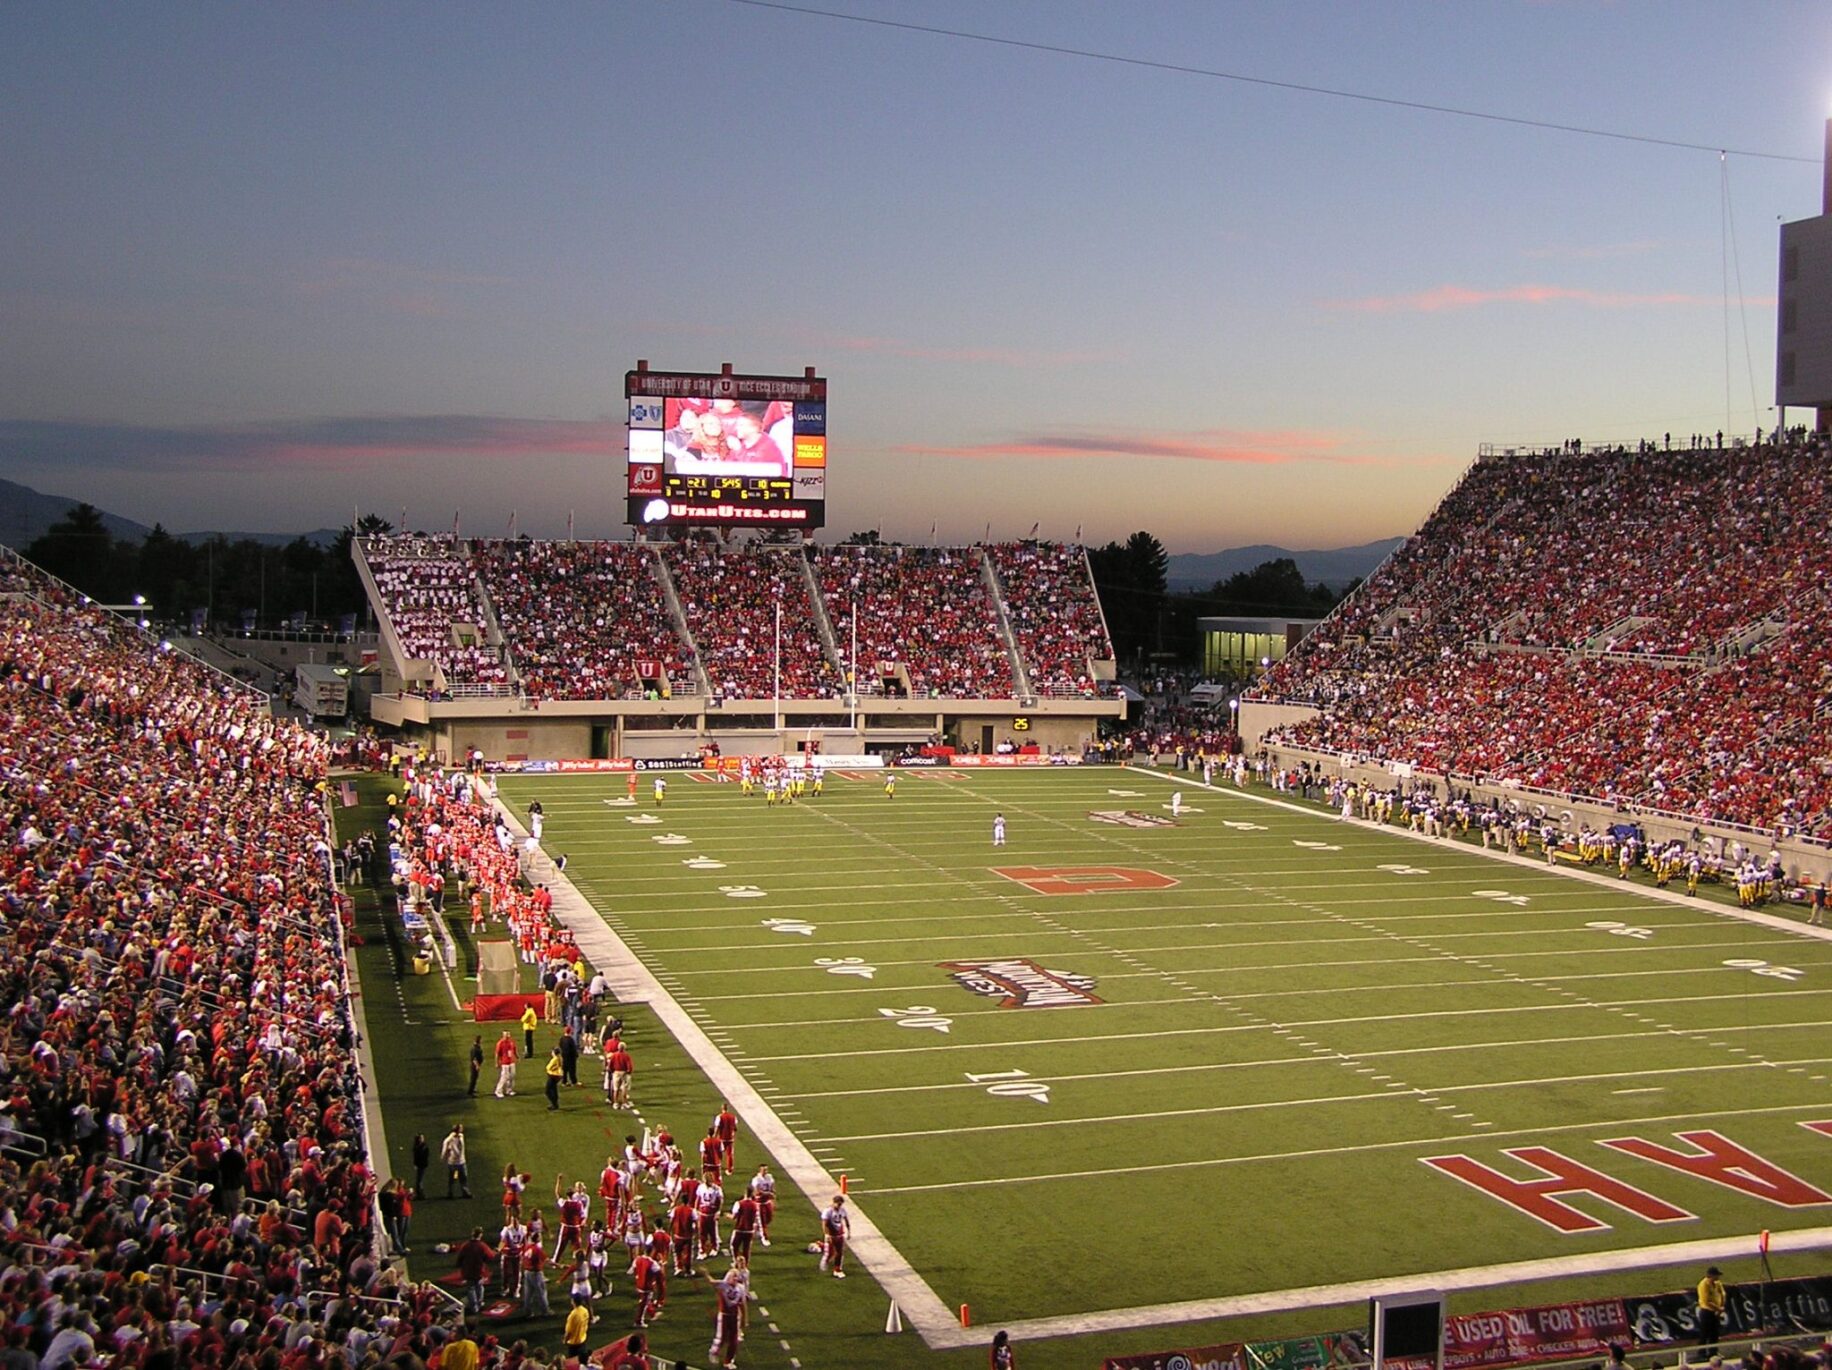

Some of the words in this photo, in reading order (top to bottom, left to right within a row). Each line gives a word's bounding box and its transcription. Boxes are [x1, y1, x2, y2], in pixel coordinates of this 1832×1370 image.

[641, 662, 655, 677] U
[1014, 718, 1028, 730] 25
[814, 957, 877, 976] 30
[954, 970, 1017, 998] WEST
[878, 1006, 954, 1028] 20
[964, 1069, 1051, 1097] 10
[1457, 1316, 1504, 1342] USED
[1509, 1312, 1536, 1336] OIL
[1538, 1308, 1574, 1333] FOR
[1576, 1302, 1625, 1328] FREE!
